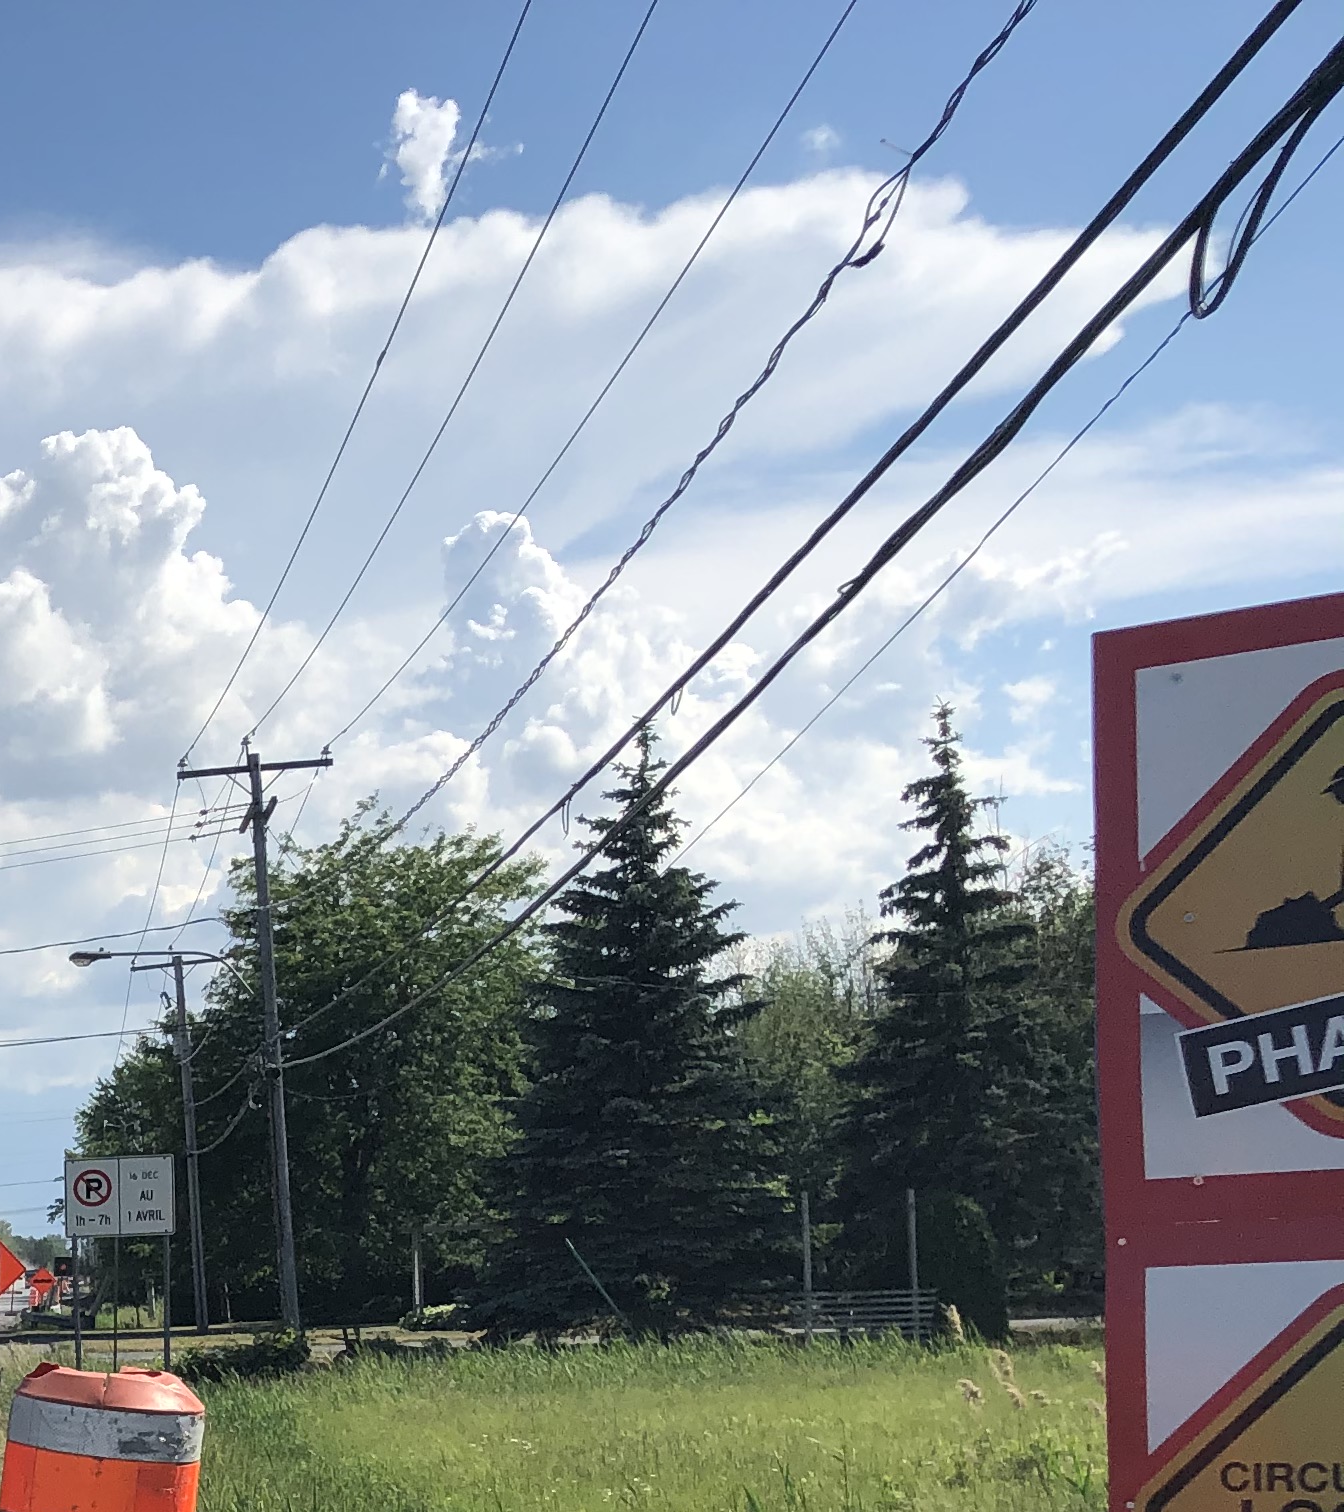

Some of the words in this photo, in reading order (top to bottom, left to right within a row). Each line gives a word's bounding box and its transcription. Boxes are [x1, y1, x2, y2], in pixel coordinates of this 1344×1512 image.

[140, 1190, 153, 1201] AU
[76, 1215, 85, 1226] 1h
[98, 1214, 110, 1225] 7h
[136, 1209, 165, 1222] AVRIL
